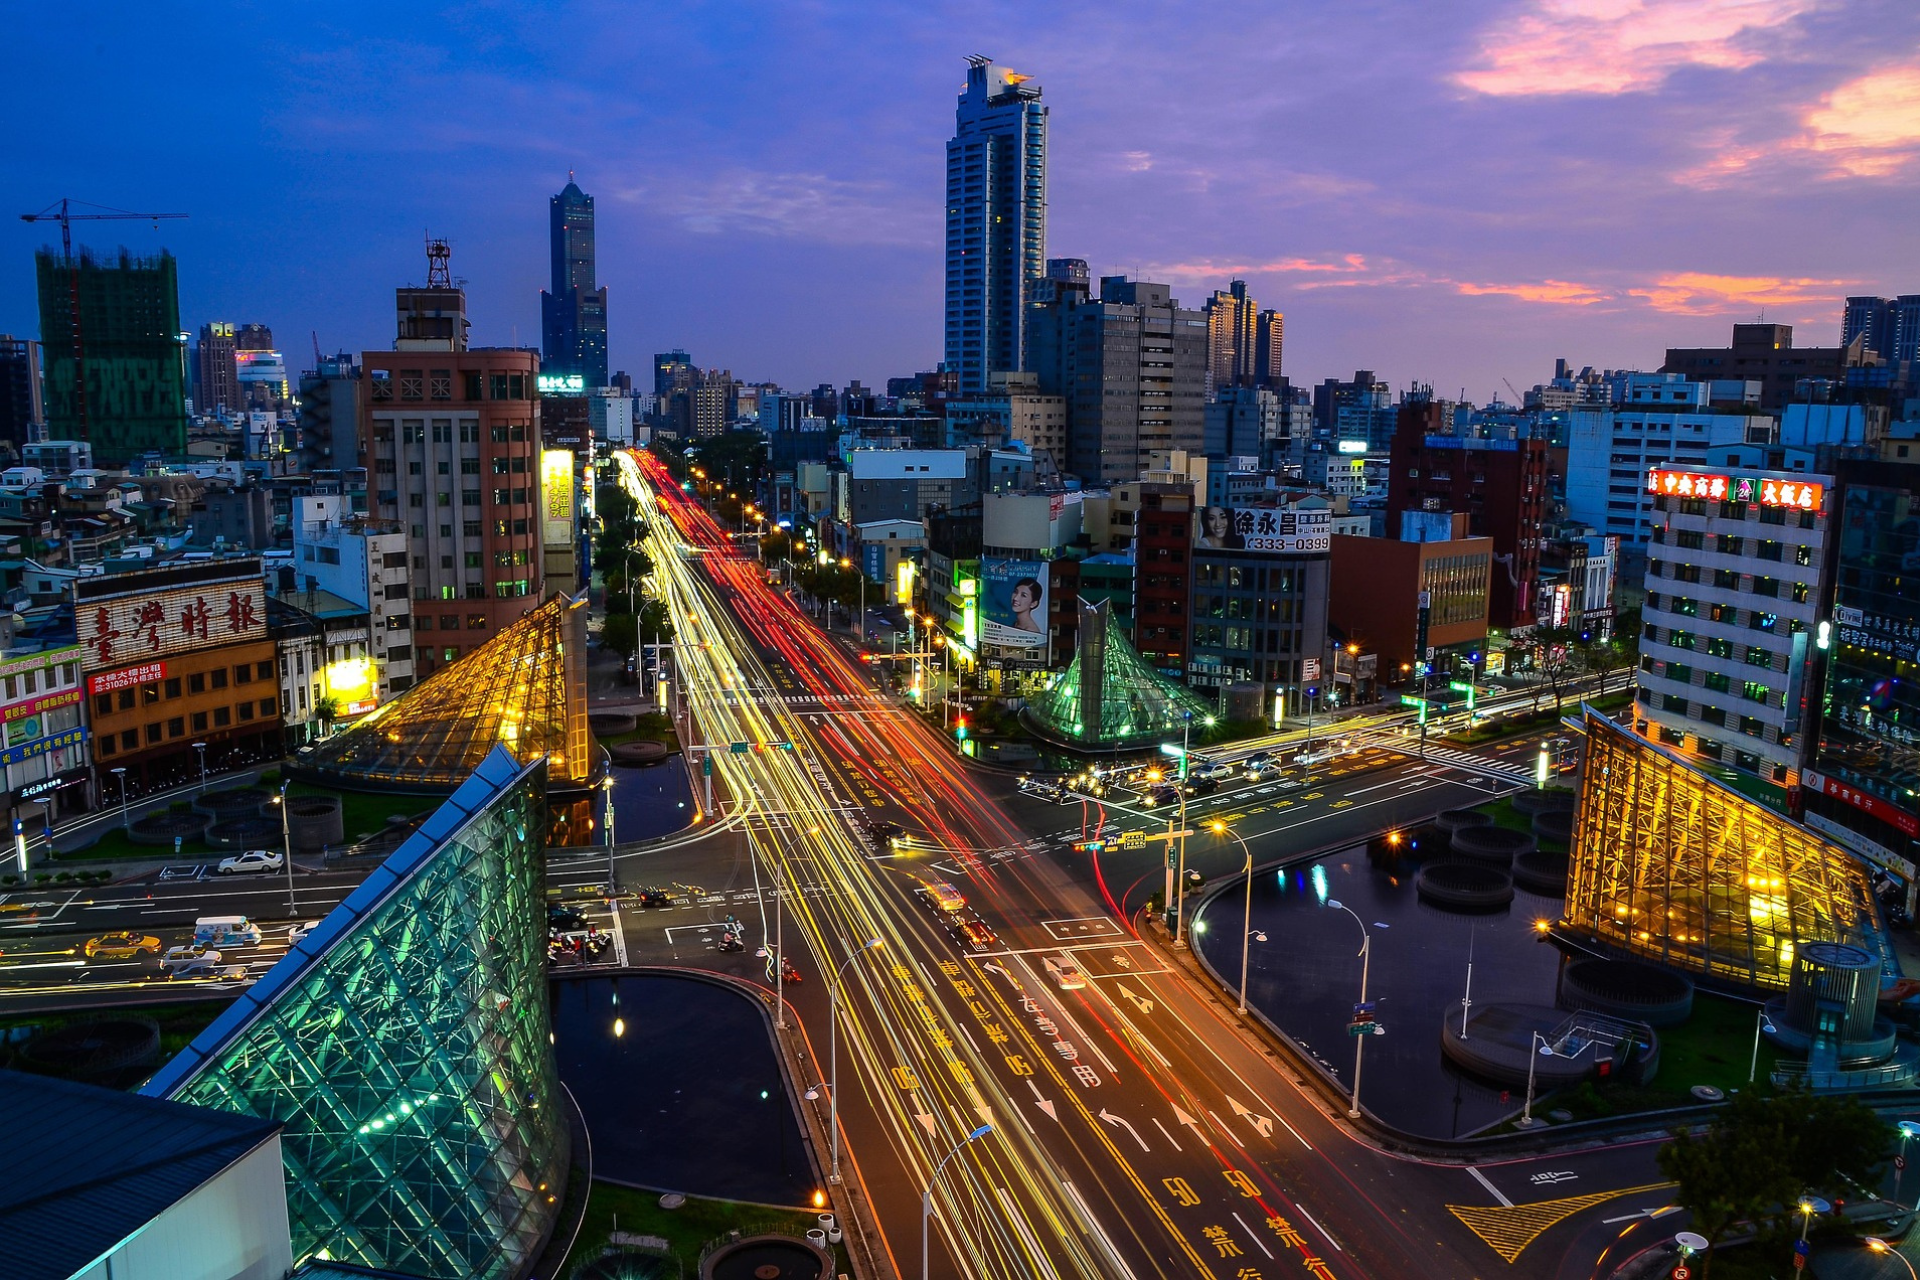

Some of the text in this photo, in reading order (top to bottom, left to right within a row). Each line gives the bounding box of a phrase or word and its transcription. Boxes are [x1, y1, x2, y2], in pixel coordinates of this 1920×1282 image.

[1664, 473, 1726, 498] 中央商務
[1763, 483, 1813, 508] 大飯店
[1235, 510, 1297, 536] 徐永昌
[1254, 537, 1329, 550] 333-0399
[87, 591, 263, 662] 臺灣時報
[1162, 1176, 1202, 1207] 50
[1222, 1169, 1262, 1198] 50
